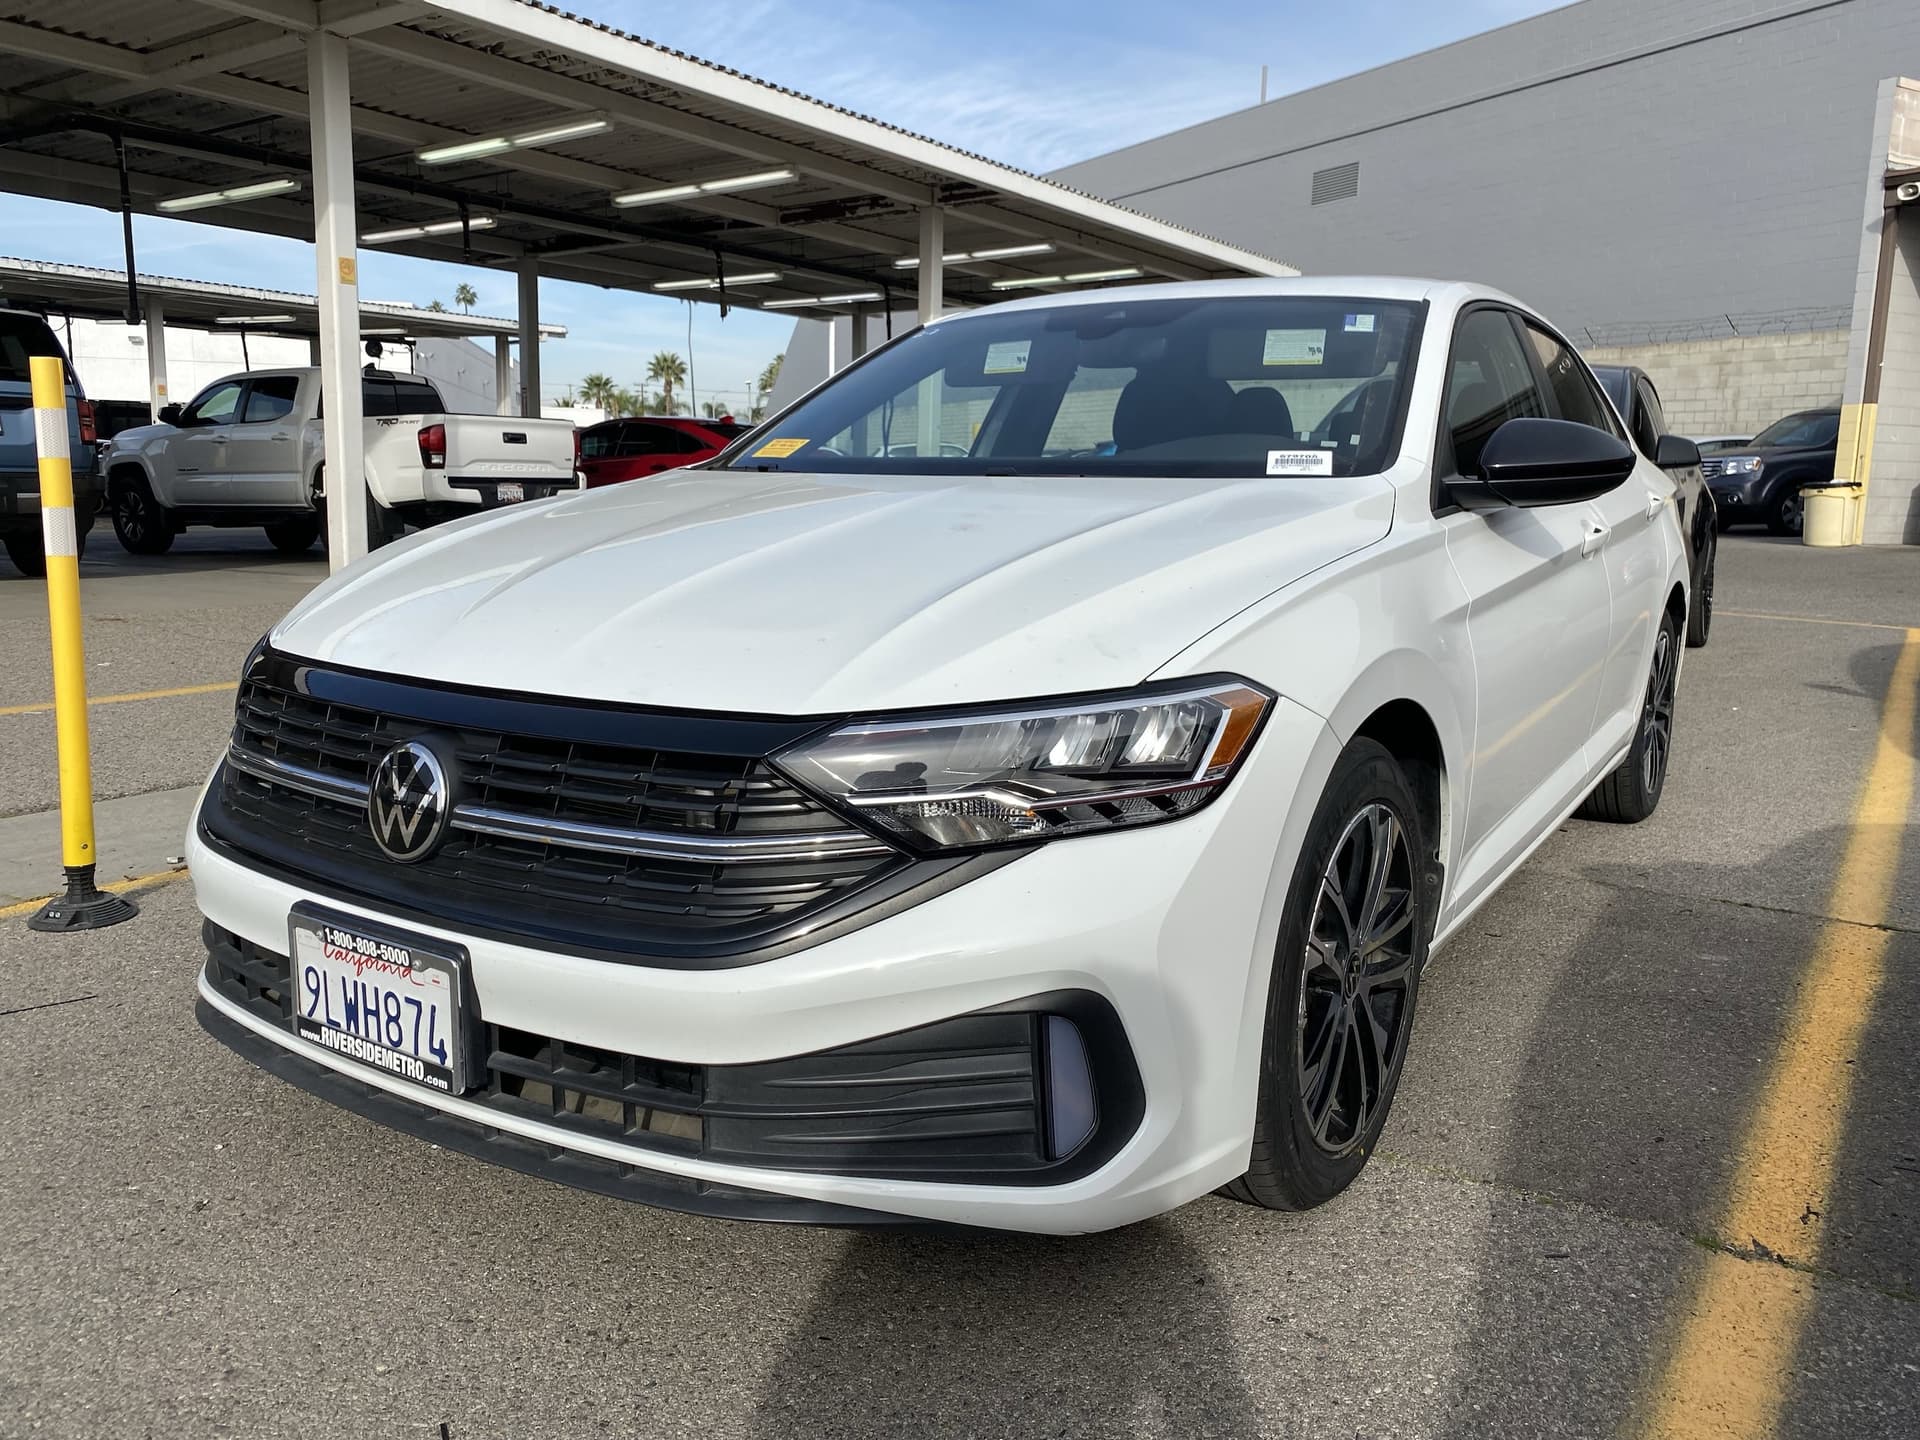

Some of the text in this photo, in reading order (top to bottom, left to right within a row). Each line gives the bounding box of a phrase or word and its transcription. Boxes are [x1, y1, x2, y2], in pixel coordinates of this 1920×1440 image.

[376, 418, 399, 427] TRD
[480, 463, 551, 473] TACOMA
[324, 928, 410, 966] 1-800-808-5000
[304, 965, 448, 1066] 9LWH874
[300, 1026, 448, 1090] www.RIVERSIDEMETRO.com
